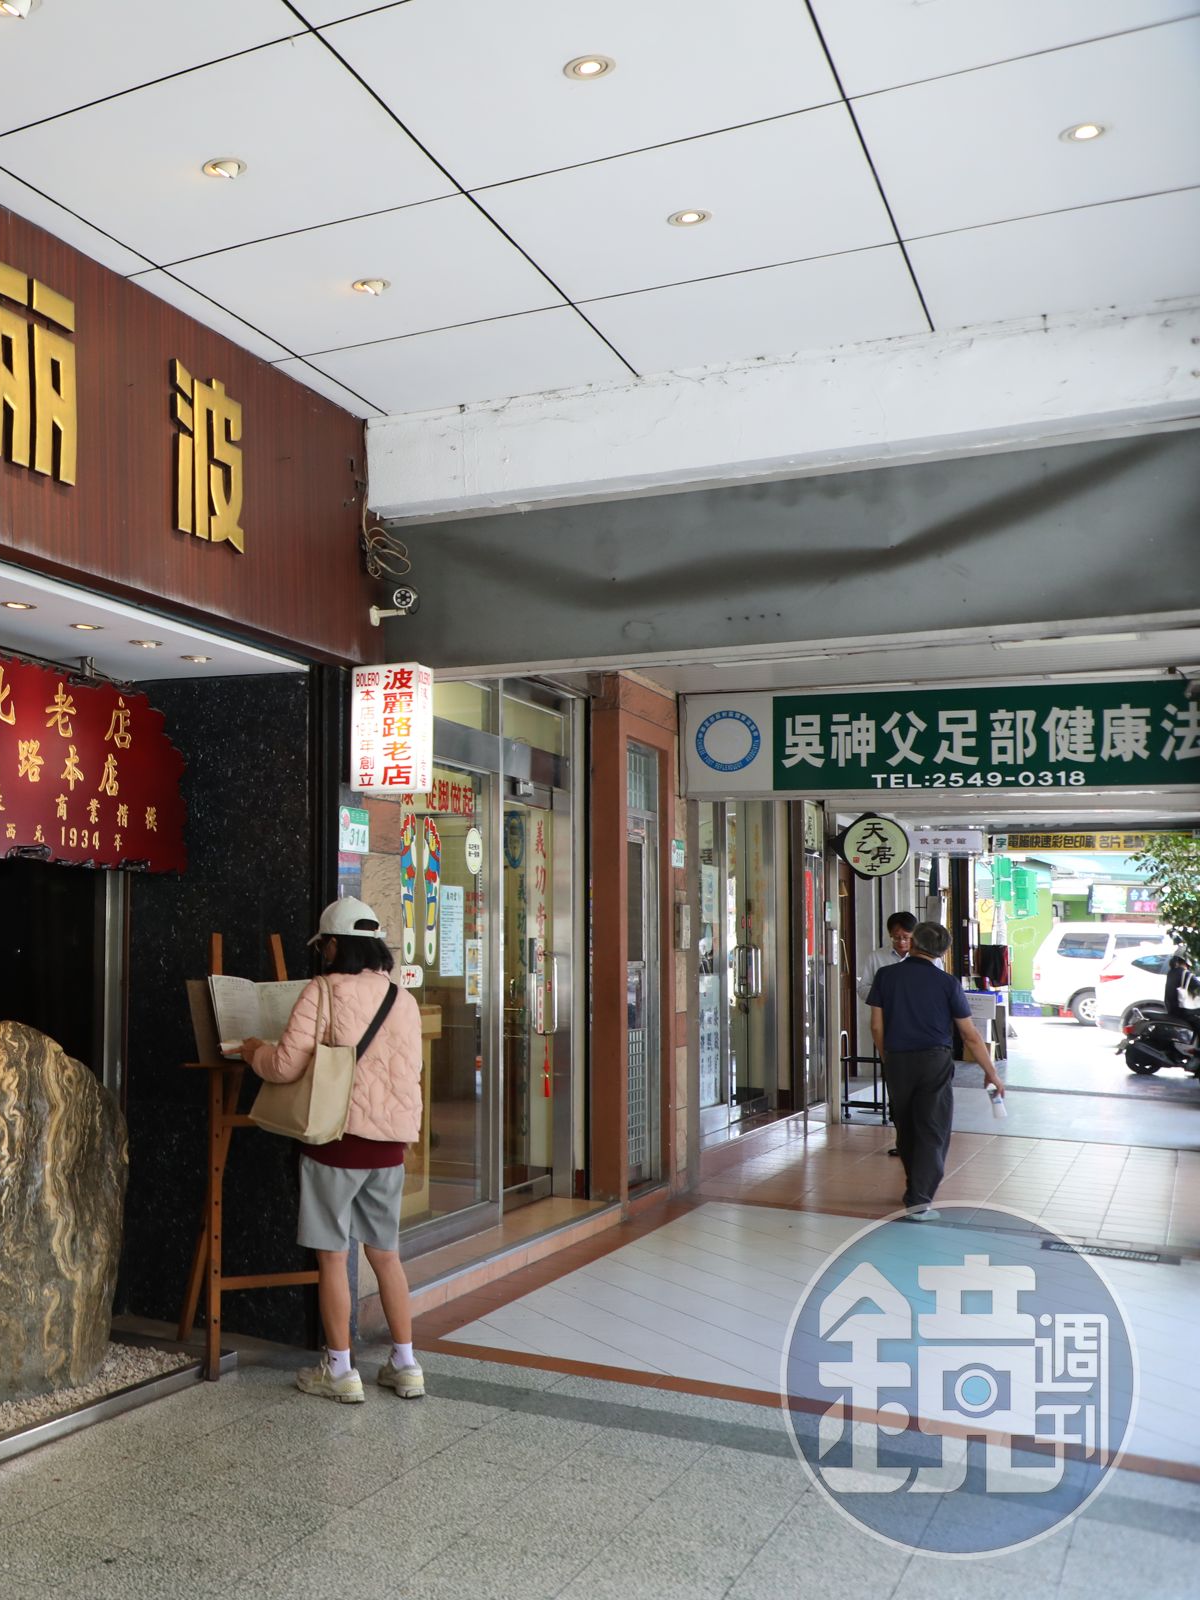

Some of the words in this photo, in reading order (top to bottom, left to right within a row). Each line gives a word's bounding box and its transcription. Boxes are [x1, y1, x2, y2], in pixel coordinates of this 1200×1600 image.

[356, 672, 380, 688] BOLERO
[381, 668, 414, 786] 波麗路老店
[781, 701, 1200, 768] 吳神父足部健康法
[871, 771, 1086, 788] TEL:2549-0318
[349, 828, 366, 847] 314
